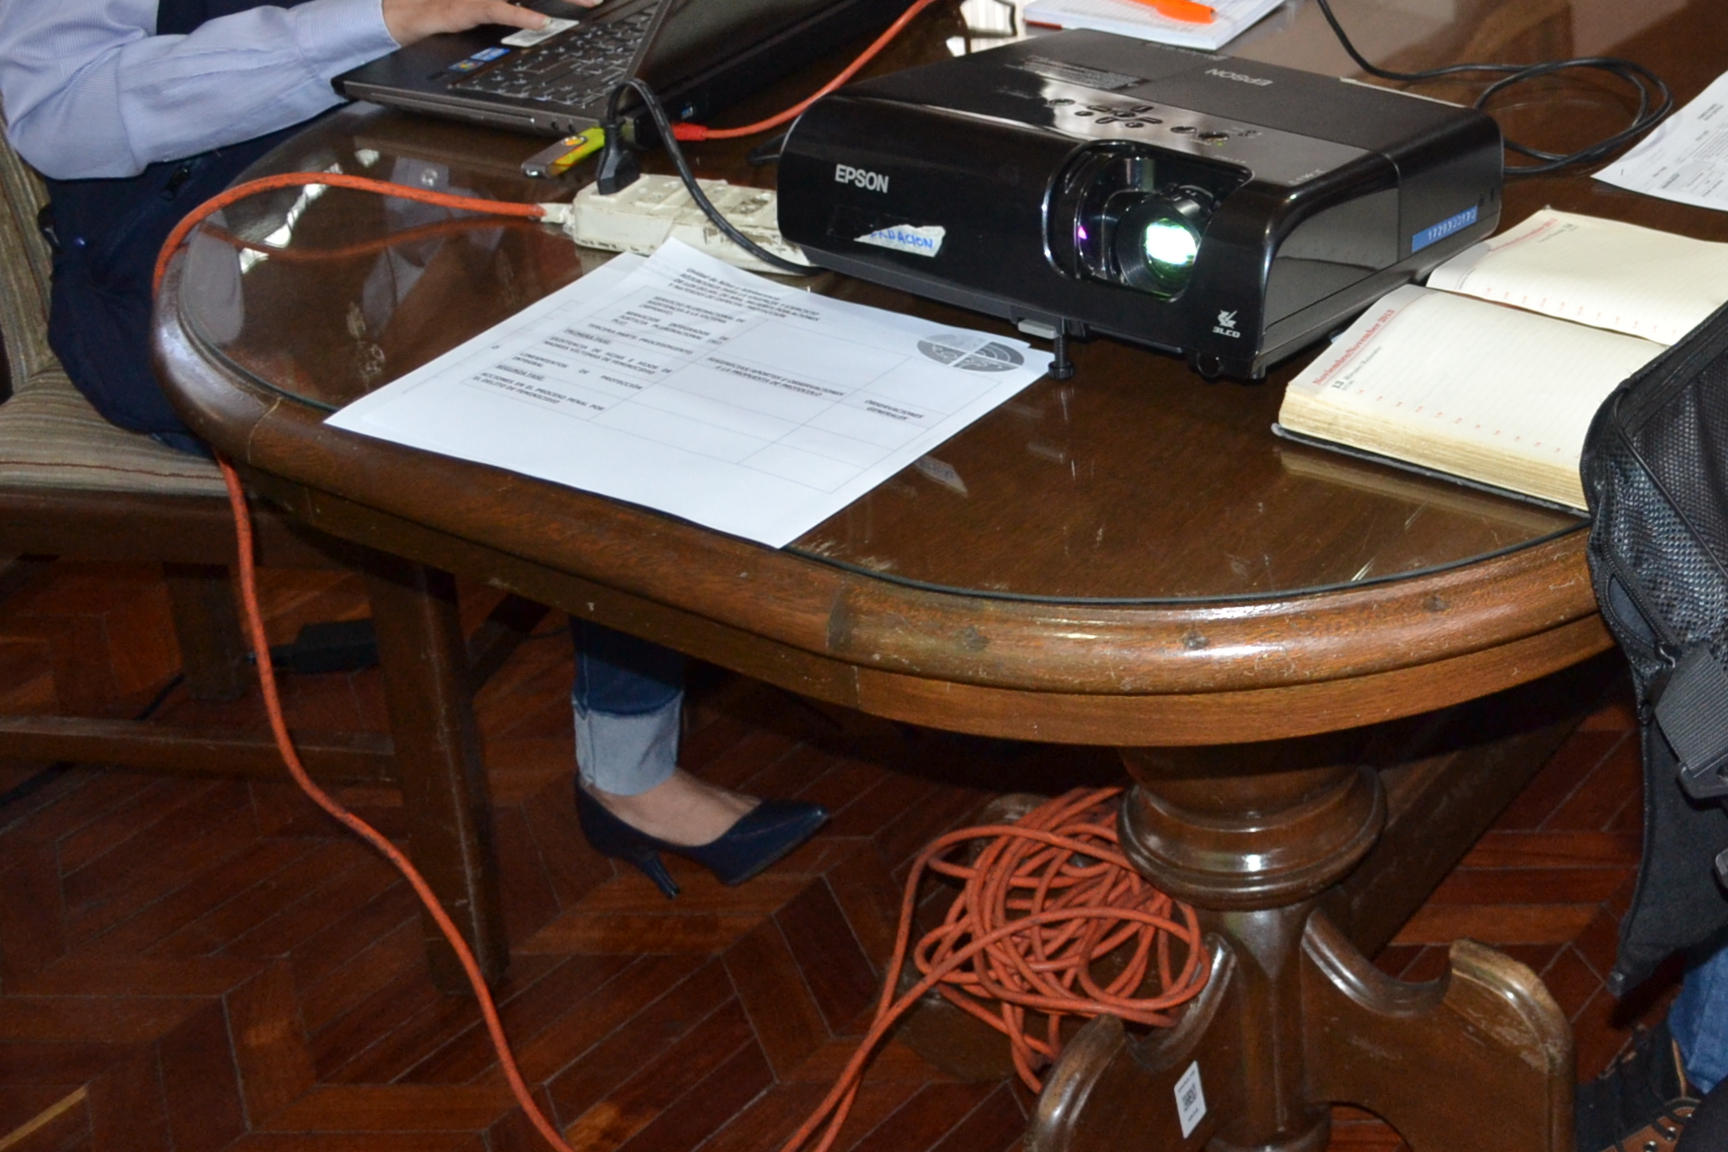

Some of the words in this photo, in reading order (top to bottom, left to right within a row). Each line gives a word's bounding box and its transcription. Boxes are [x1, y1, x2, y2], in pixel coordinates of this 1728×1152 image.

[1204, 68, 1273, 86] EPSON
[835, 163, 889, 193] EPSON
[1212, 325, 1241, 339] 3LCD
